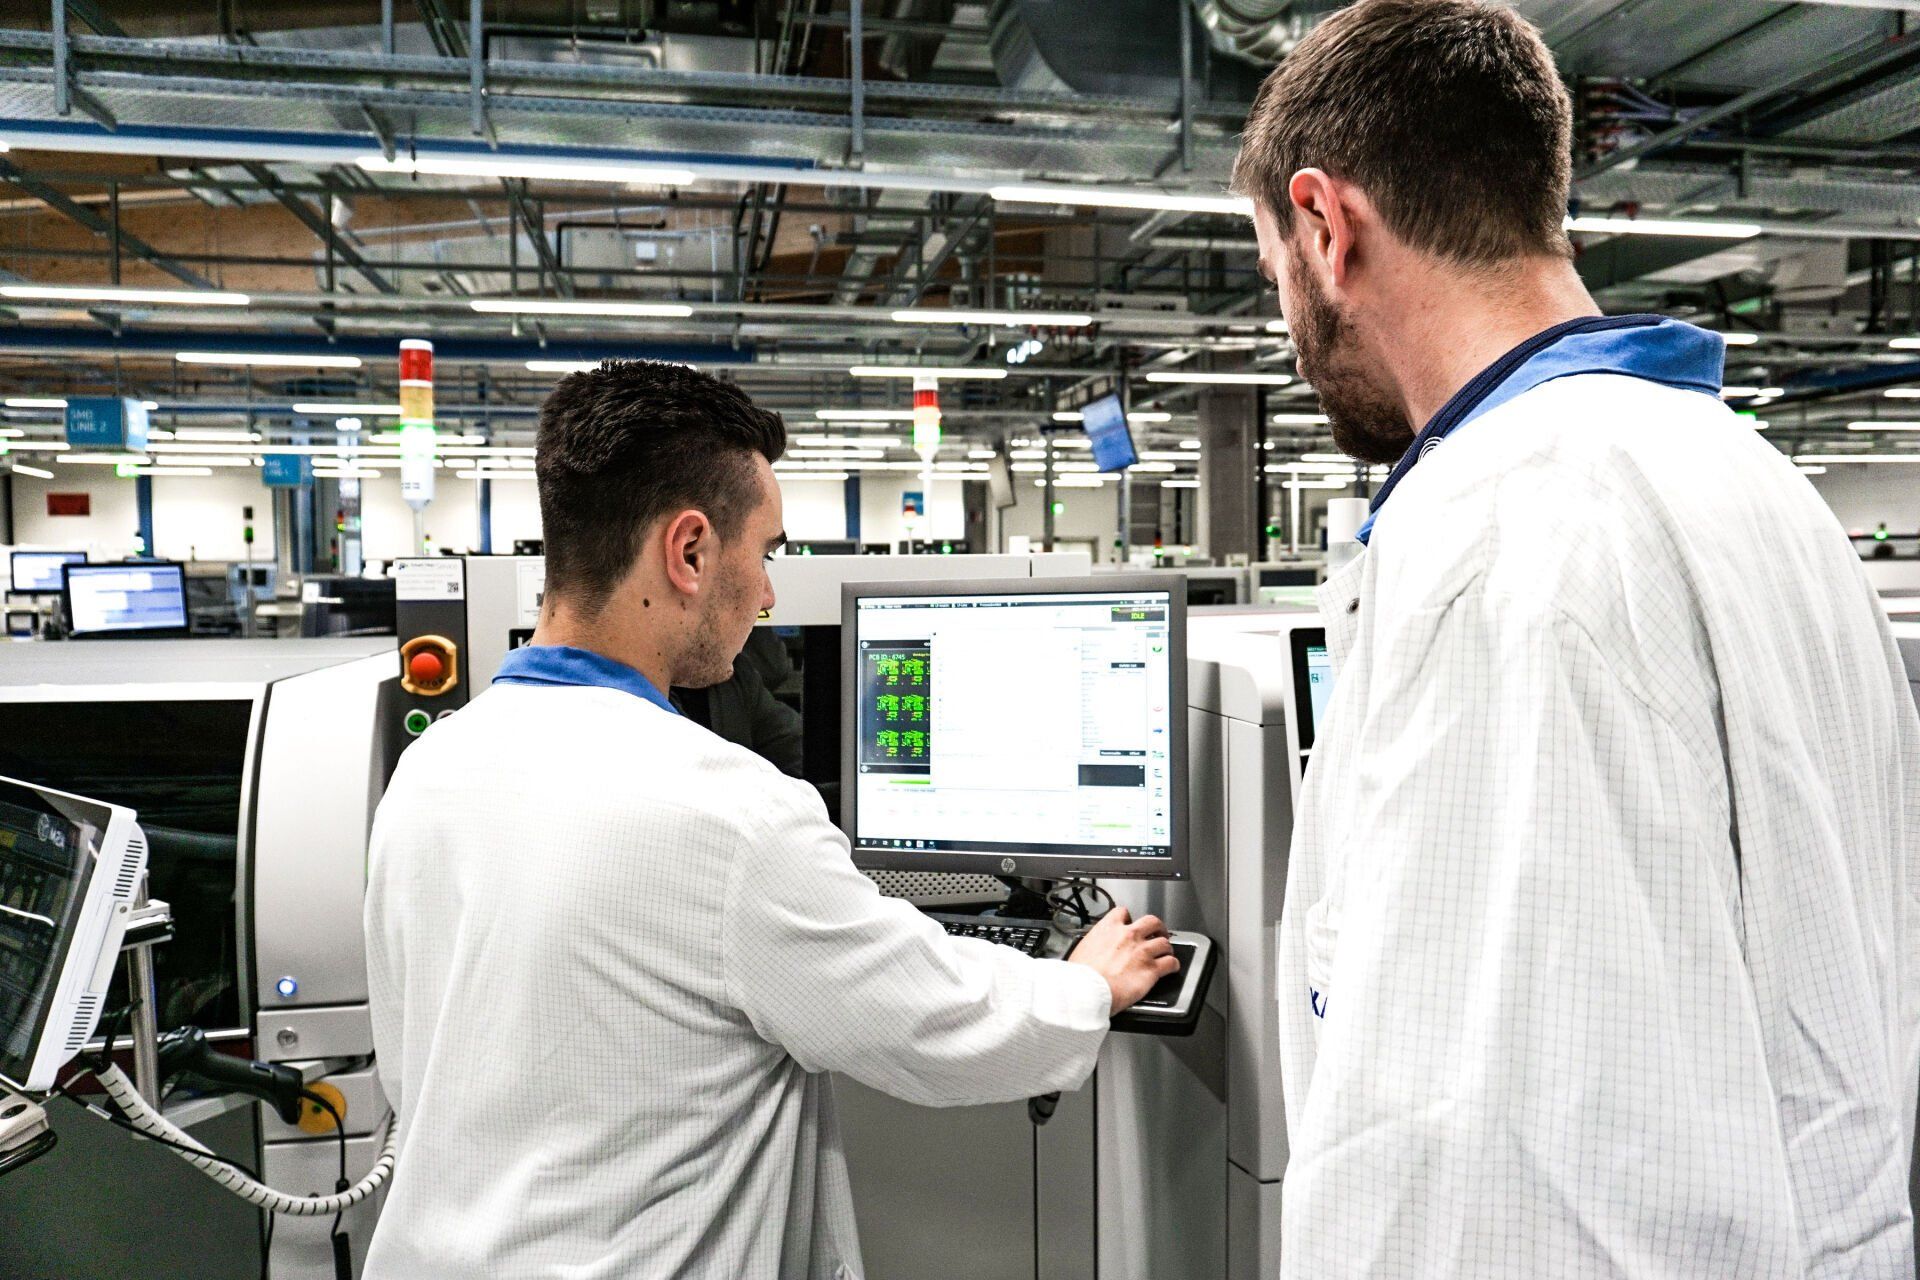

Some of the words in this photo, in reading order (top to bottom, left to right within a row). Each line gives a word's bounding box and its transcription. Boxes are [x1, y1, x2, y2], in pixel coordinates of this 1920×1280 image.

[70, 421, 96, 432] LINIE
[1131, 612, 1145, 620] IDLE
[1001, 857, 1016, 873] hp
